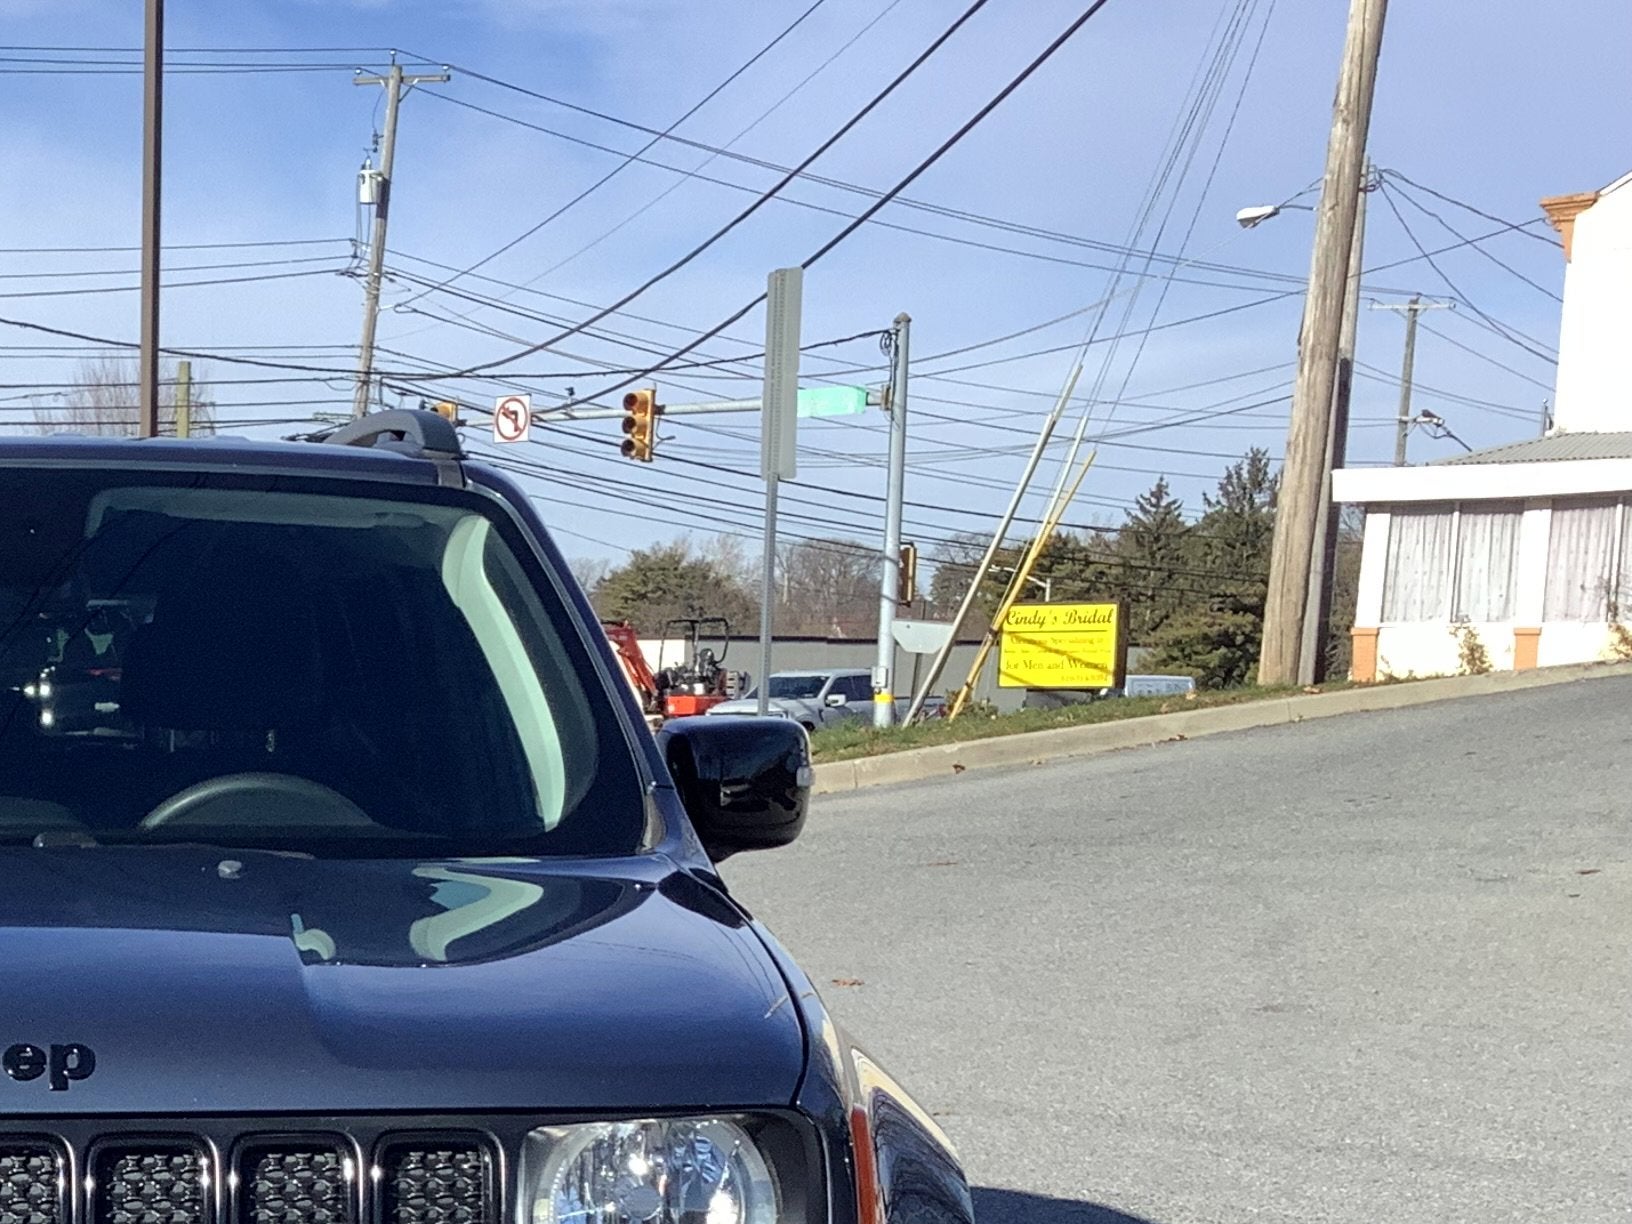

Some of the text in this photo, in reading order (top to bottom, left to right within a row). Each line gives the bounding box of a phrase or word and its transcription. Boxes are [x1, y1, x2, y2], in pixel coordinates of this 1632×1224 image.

[1006, 608, 1114, 628] Cindy's Bridal
[1023, 659, 1045, 670] Men
[1047, 659, 1065, 670] and
